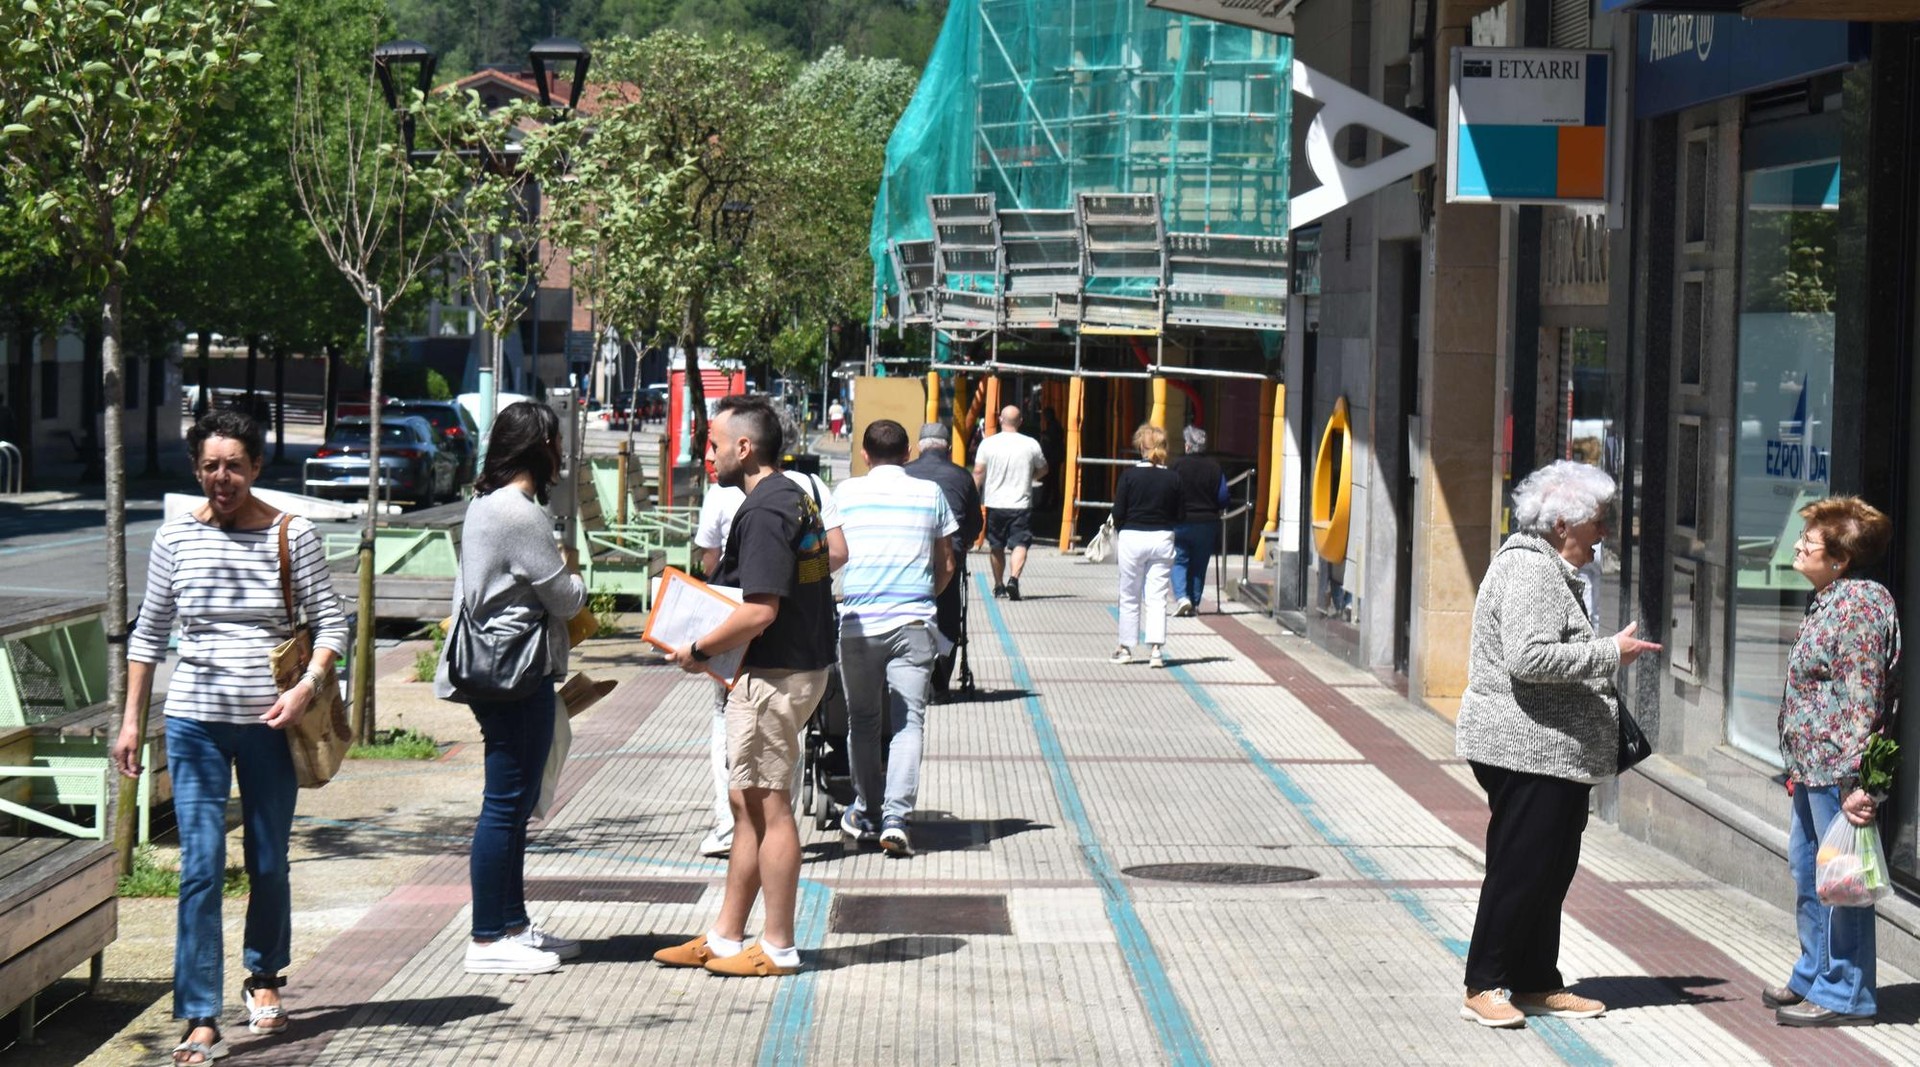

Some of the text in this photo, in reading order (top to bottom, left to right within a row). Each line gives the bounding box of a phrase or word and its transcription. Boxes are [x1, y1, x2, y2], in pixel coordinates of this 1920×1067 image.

[1649, 14, 1694, 63] Allianz
[1498, 60, 1580, 80] ETXARRI
[1766, 439, 1828, 484] EZPONDA
